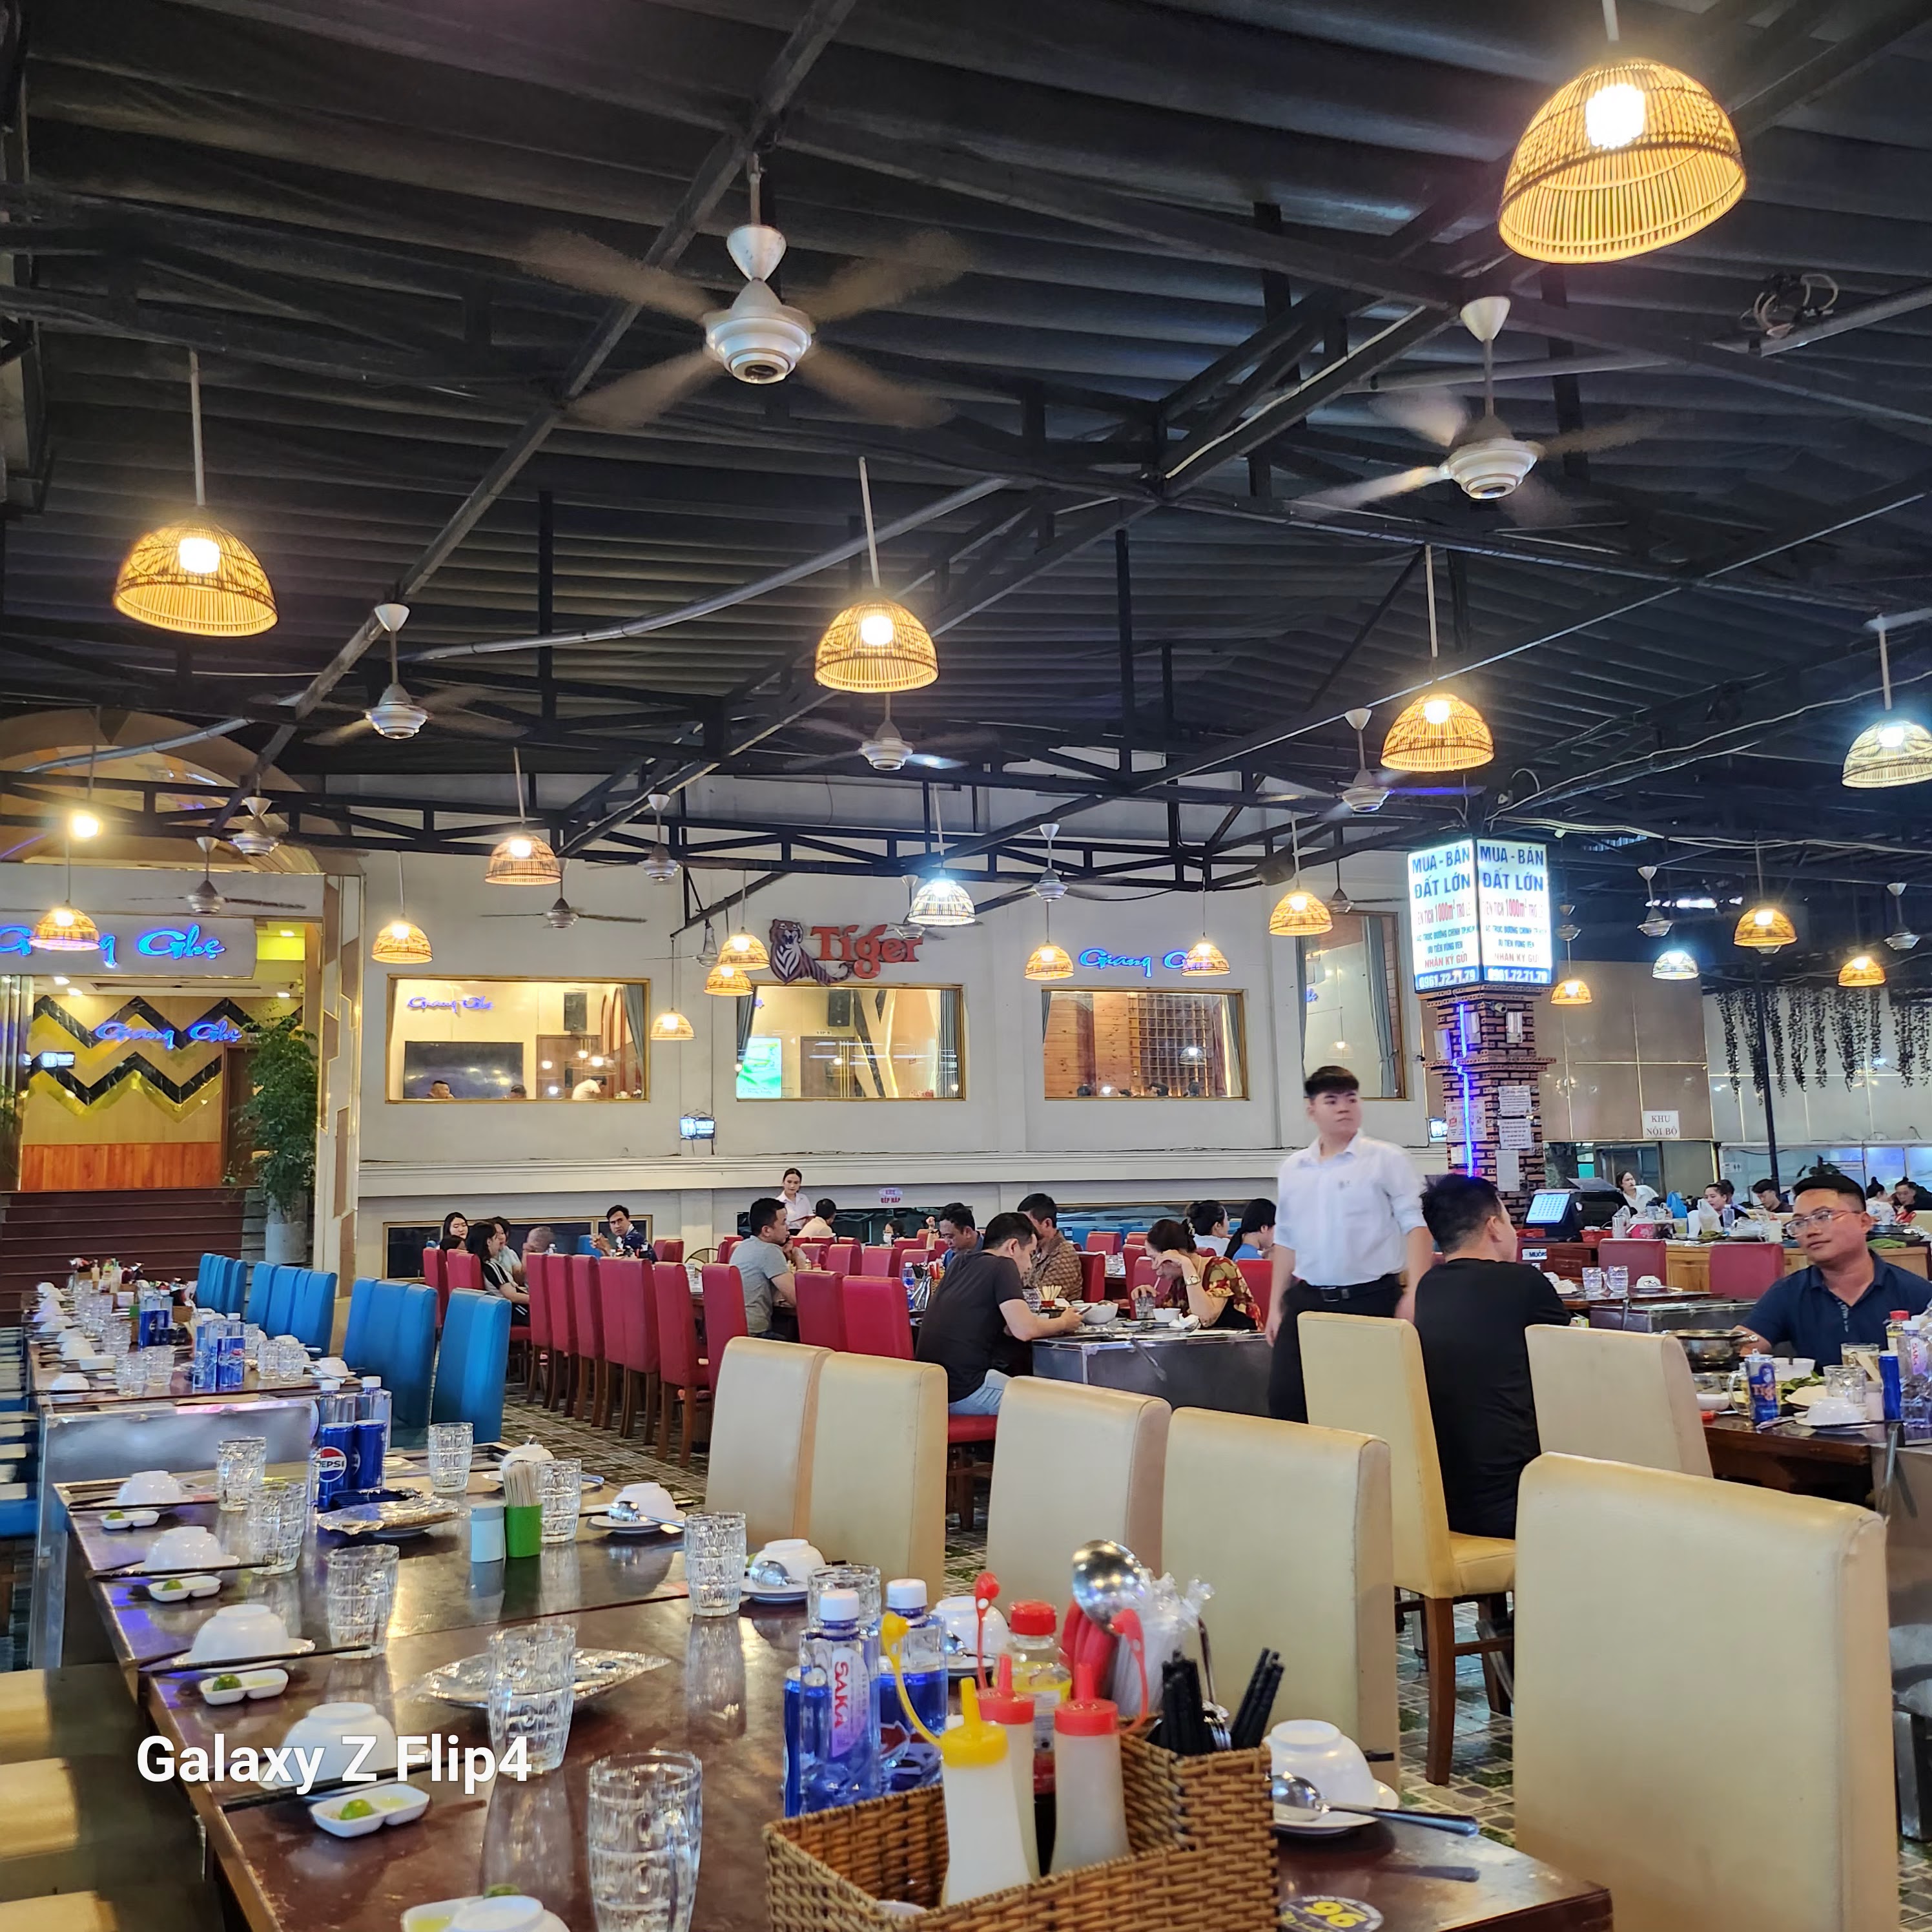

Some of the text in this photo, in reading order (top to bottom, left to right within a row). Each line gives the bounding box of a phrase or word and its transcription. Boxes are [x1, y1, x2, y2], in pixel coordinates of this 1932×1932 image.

[1412, 855, 1437, 874] MUA
[1446, 845, 1470, 867] BÁN
[1479, 846, 1508, 863] MUA
[1518, 846, 1544, 866] BÁN
[1414, 872, 1471, 899] ĐẤT LỚN
[1483, 867, 1544, 892] ĐẤT LỚN
[137, 923, 225, 960] Ghẹ
[810, 924, 923, 979] Tiger
[1079, 948, 1152, 978] Giang
[1646, 1126, 1678, 1136] NỘI BỘ
[834, 1661, 849, 1729] SAKA
